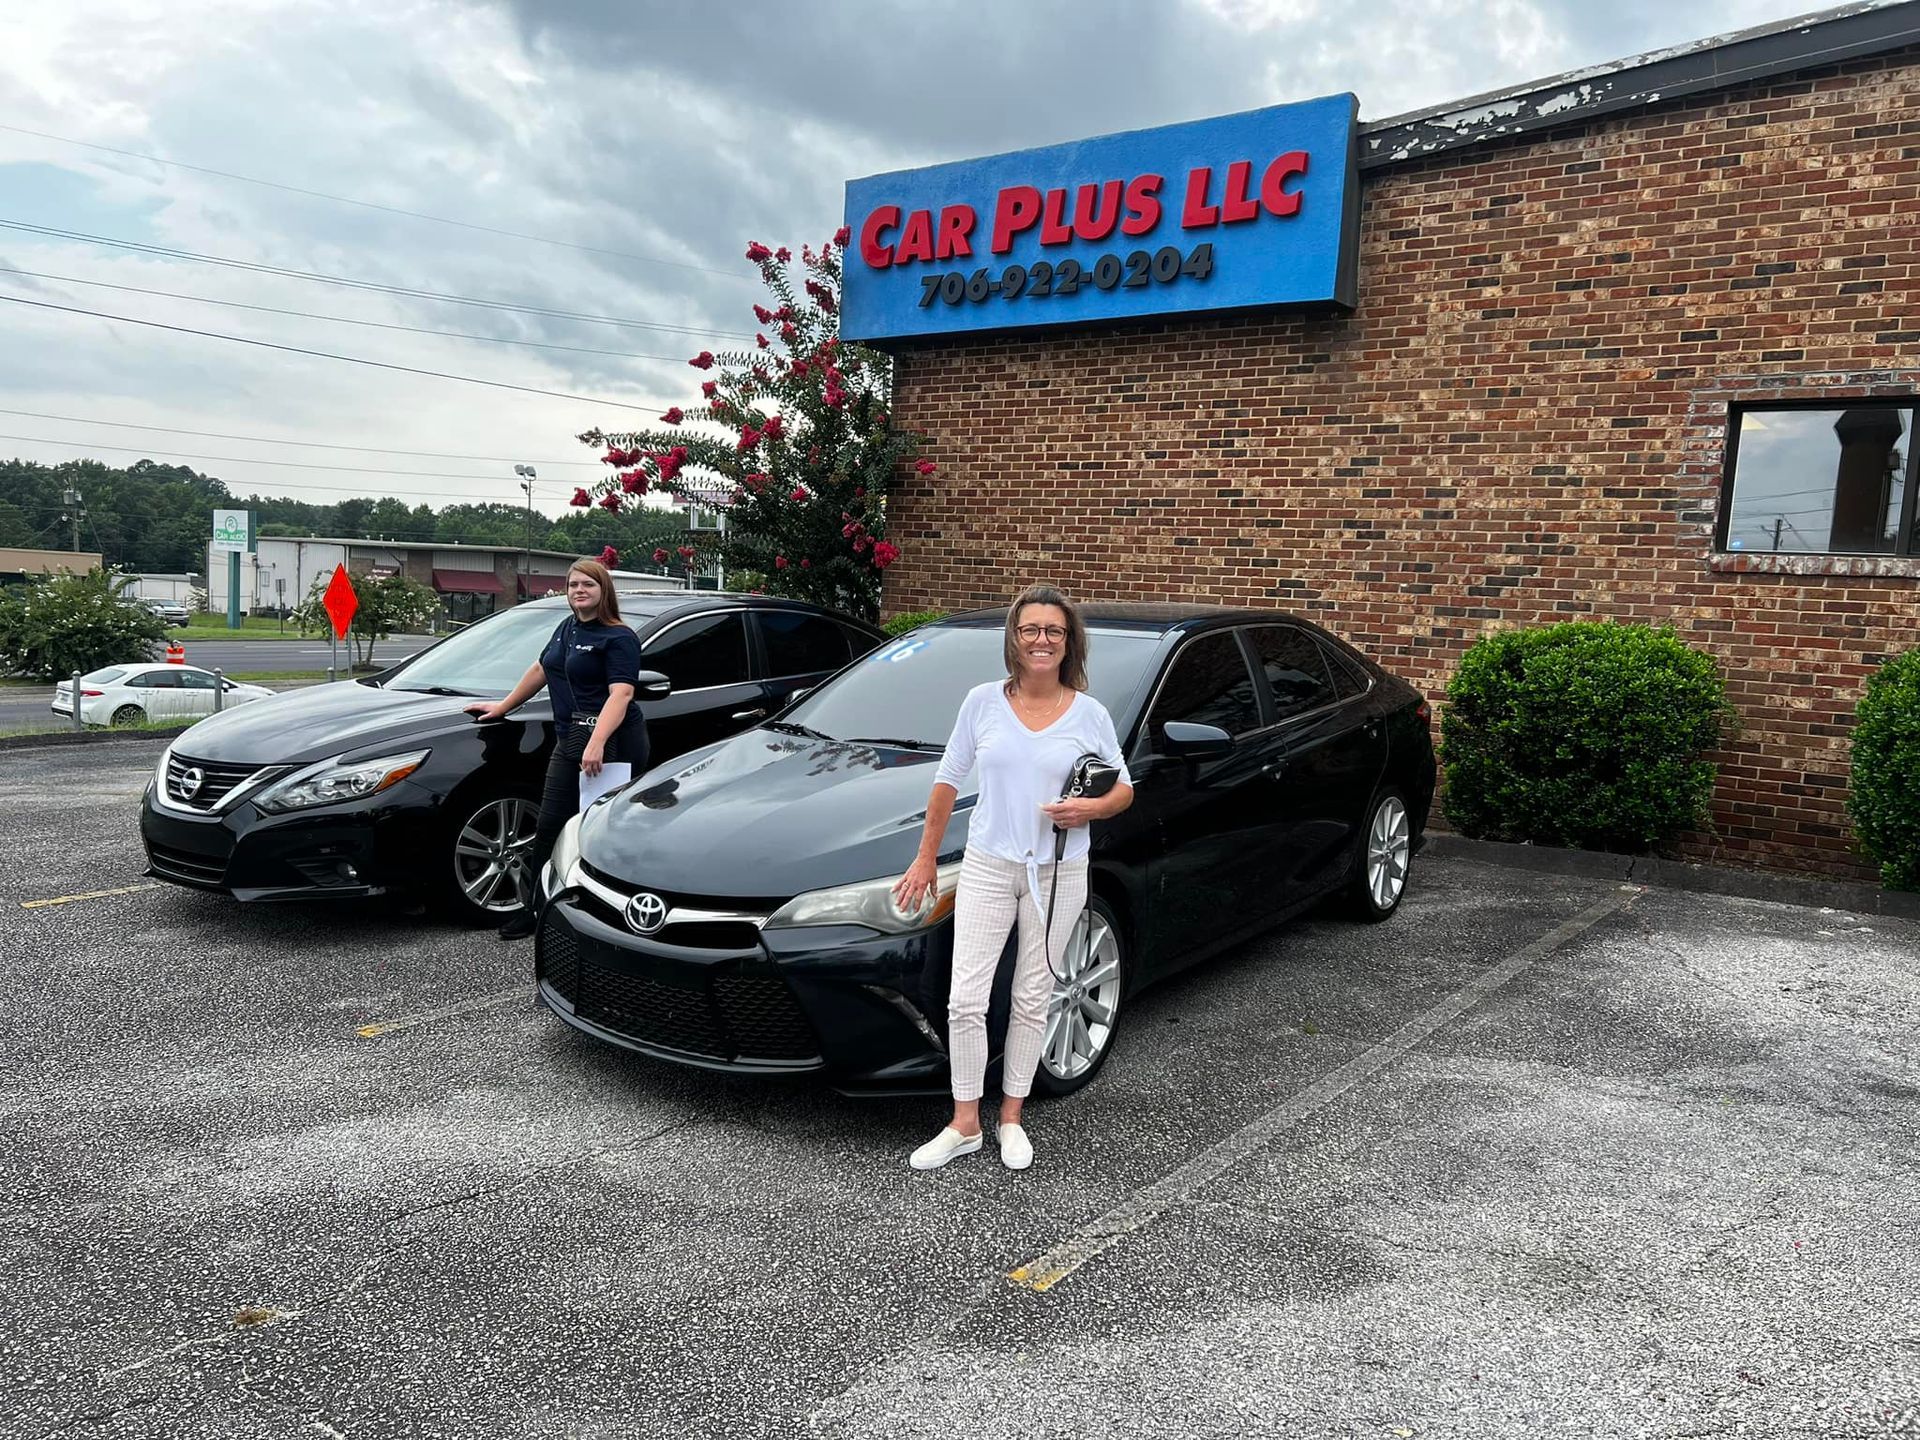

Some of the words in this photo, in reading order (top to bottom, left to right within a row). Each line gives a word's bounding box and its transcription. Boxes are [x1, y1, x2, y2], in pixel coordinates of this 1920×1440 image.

[860, 204, 976, 269] CAR
[991, 174, 1164, 255] PLUS
[1181, 151, 1309, 230] LLC
[918, 243, 1213, 308] 706-922-0204
